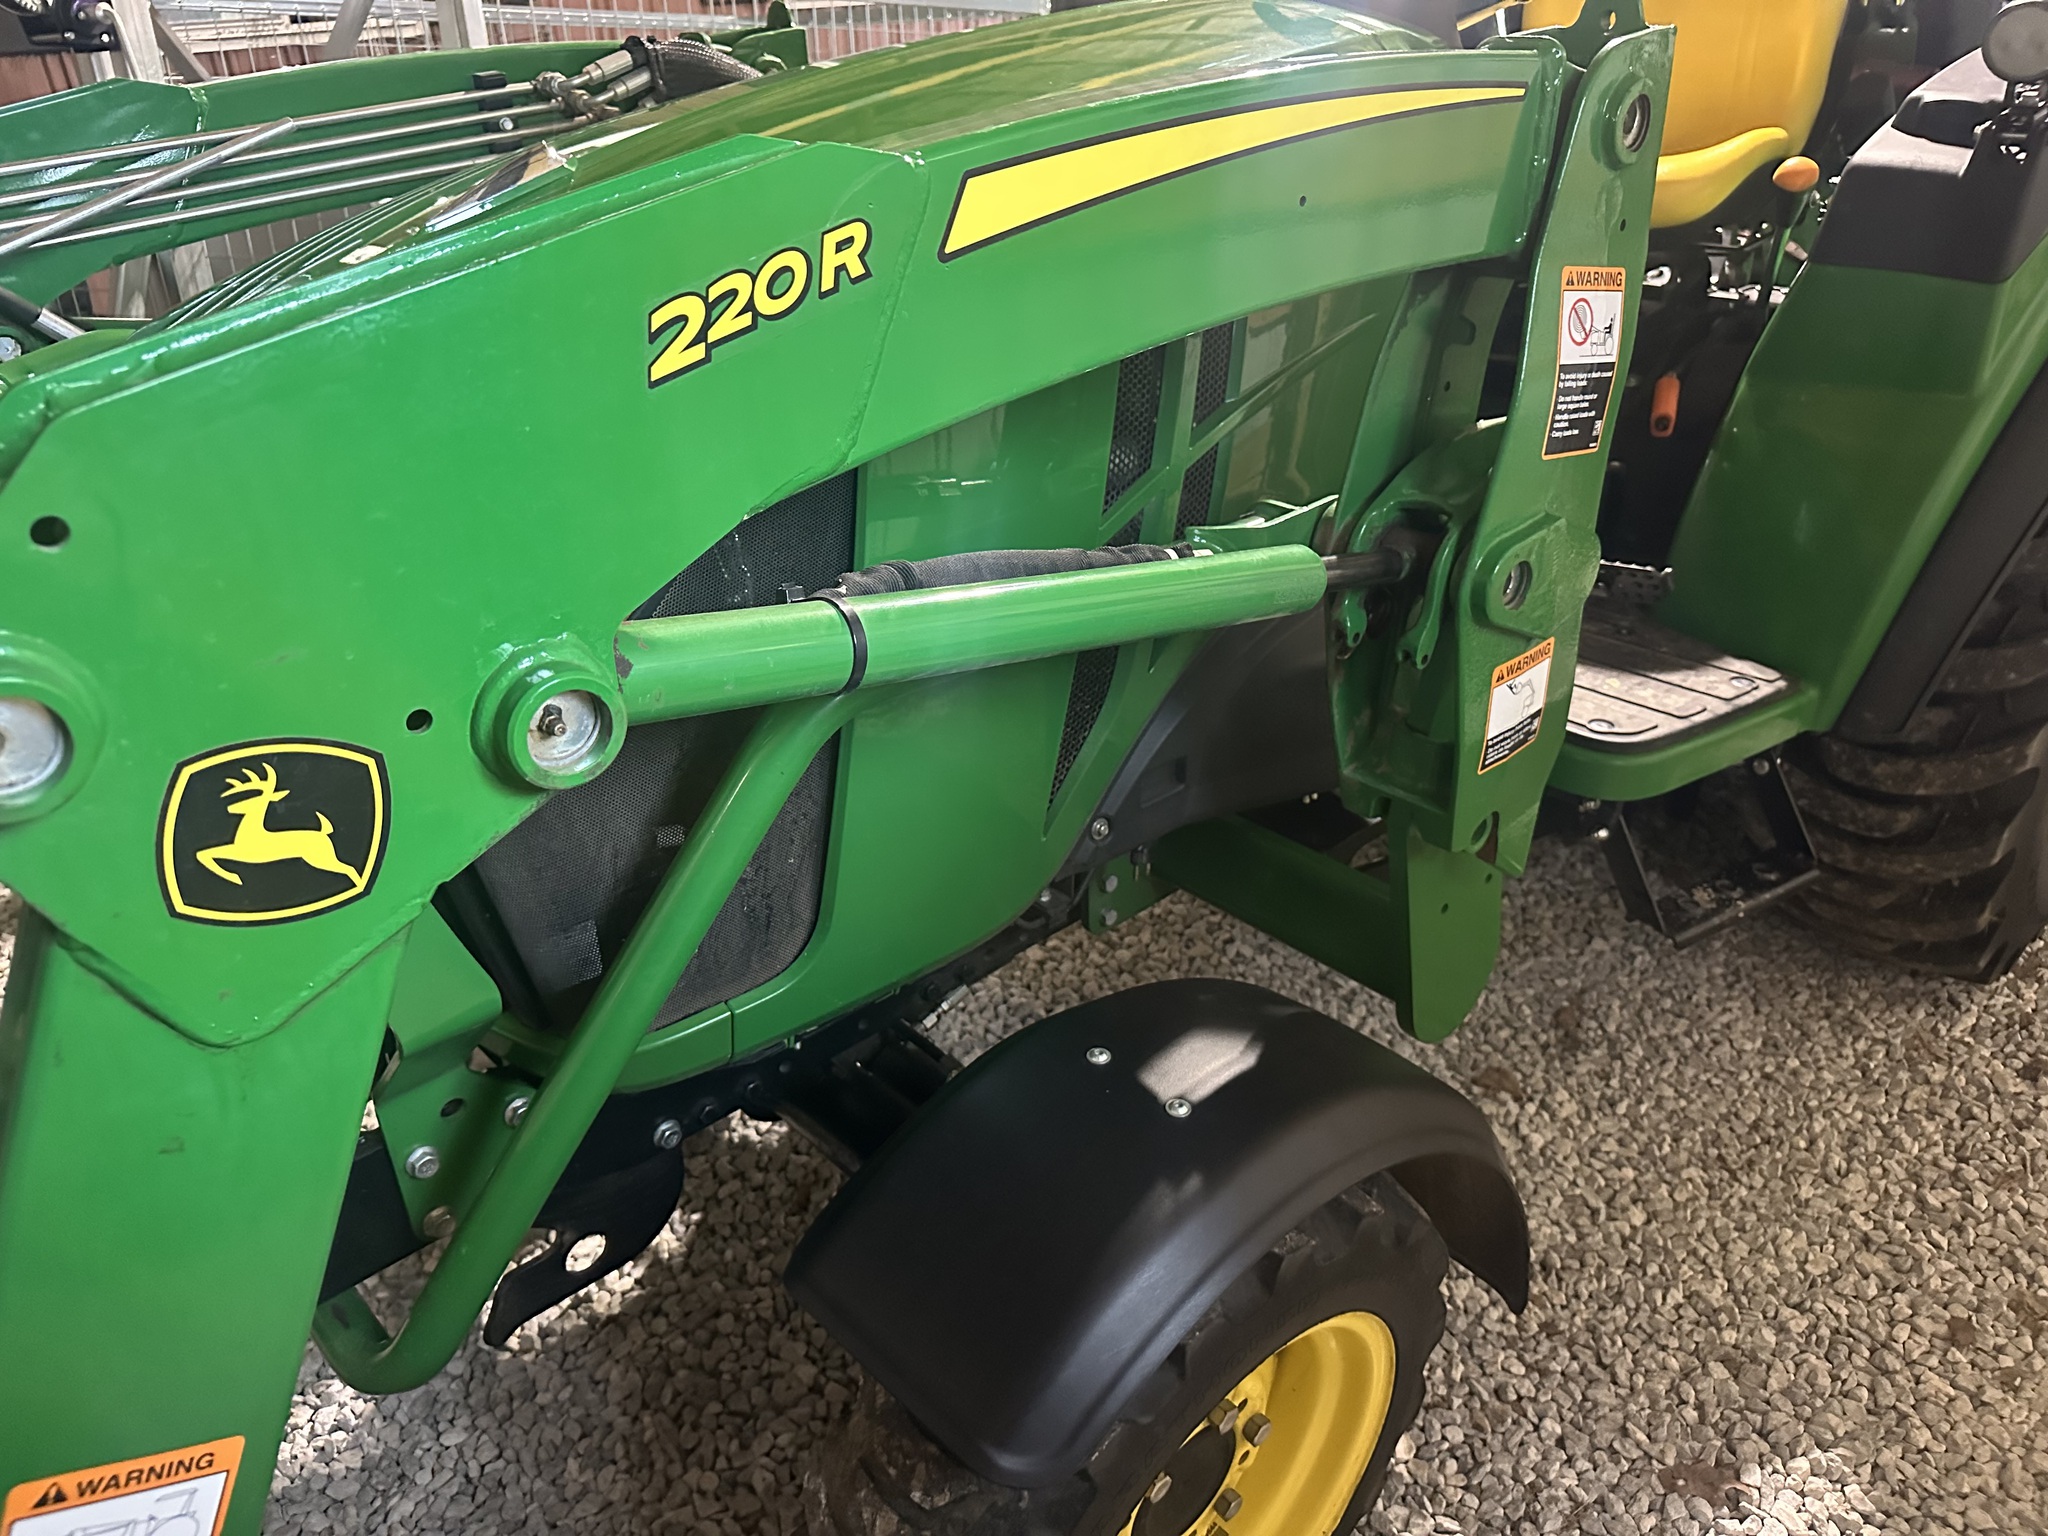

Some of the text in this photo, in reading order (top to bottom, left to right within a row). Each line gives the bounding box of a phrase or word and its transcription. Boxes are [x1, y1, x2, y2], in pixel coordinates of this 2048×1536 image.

[1576, 271, 1623, 287] WARNING
[1505, 642, 1551, 678] WARNING
[76, 1452, 215, 1498] WARNING
